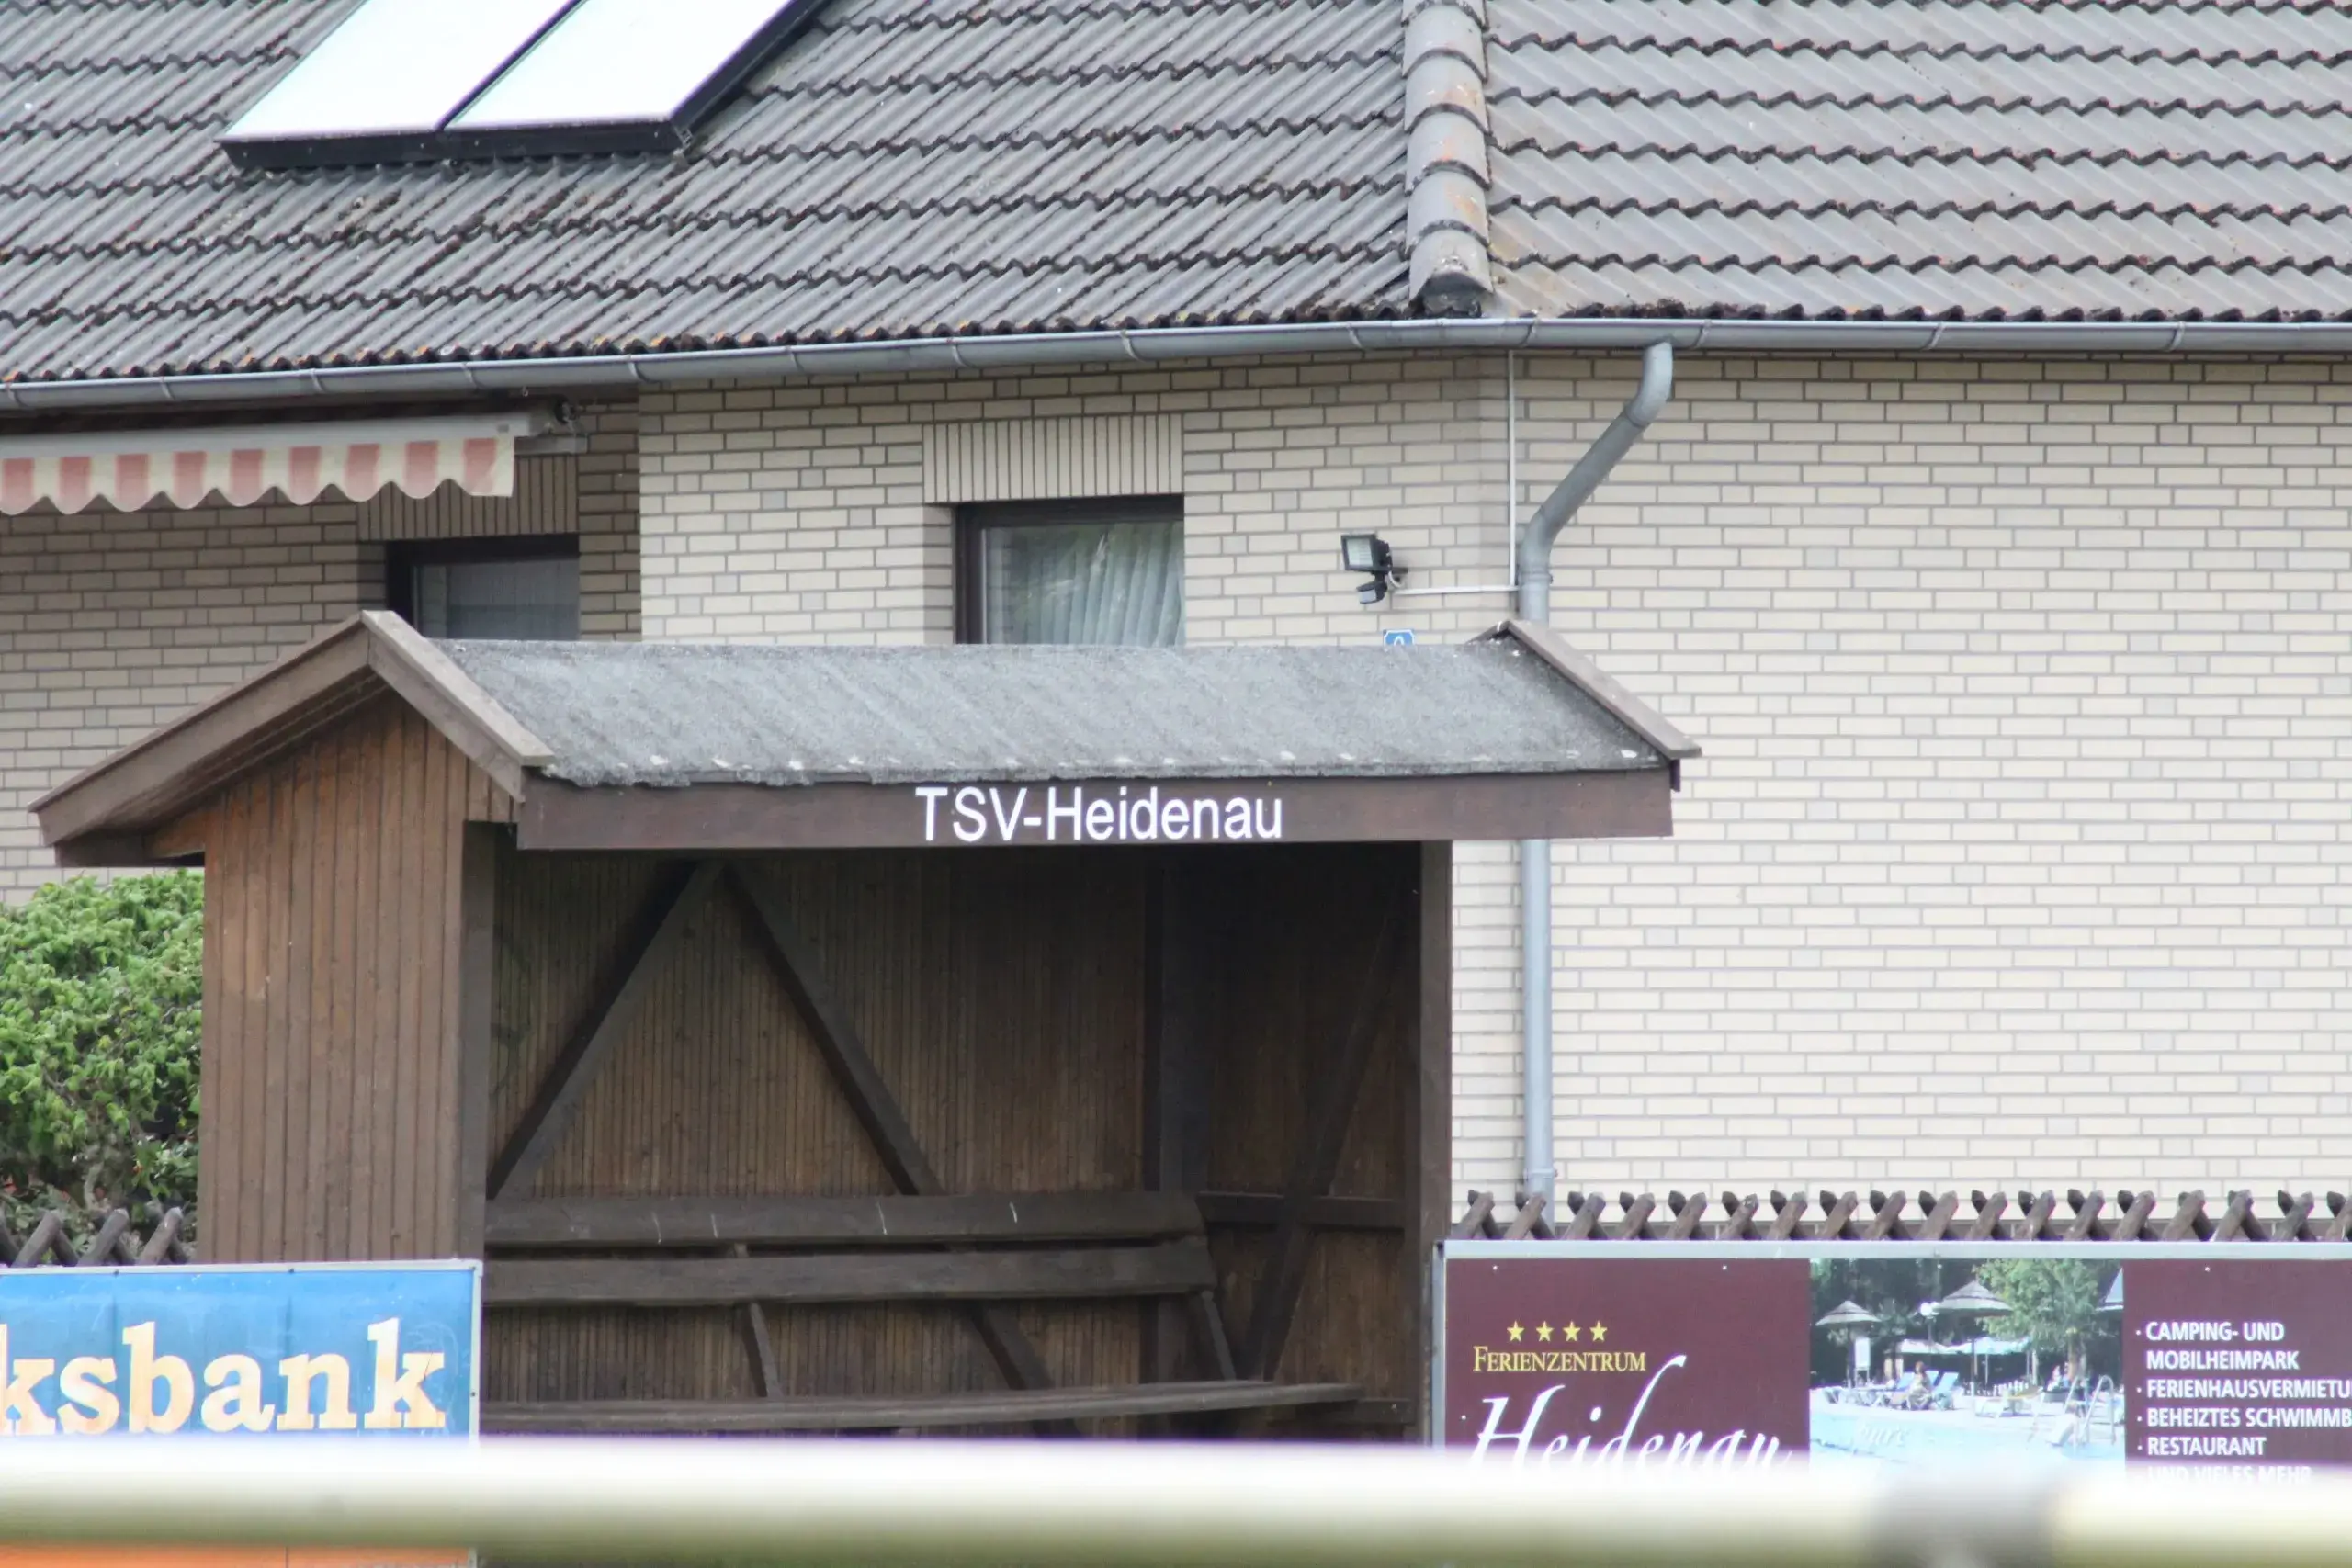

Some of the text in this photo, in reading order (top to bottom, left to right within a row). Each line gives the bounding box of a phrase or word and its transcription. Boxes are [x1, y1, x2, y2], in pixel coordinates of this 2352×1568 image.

[915, 786, 1283, 842] TSV-Heidenau
[2145, 1322, 2285, 1341] CAMPING- UND
[2146, 1350, 2300, 1370] MOBILHEIMPARK
[0, 1317, 447, 1436] ksbank
[1470, 1355, 1793, 1473] Heidenau
[2147, 1408, 2241, 1427] BEHEIZTES
[2147, 1437, 2267, 1455] RESTAURANT
